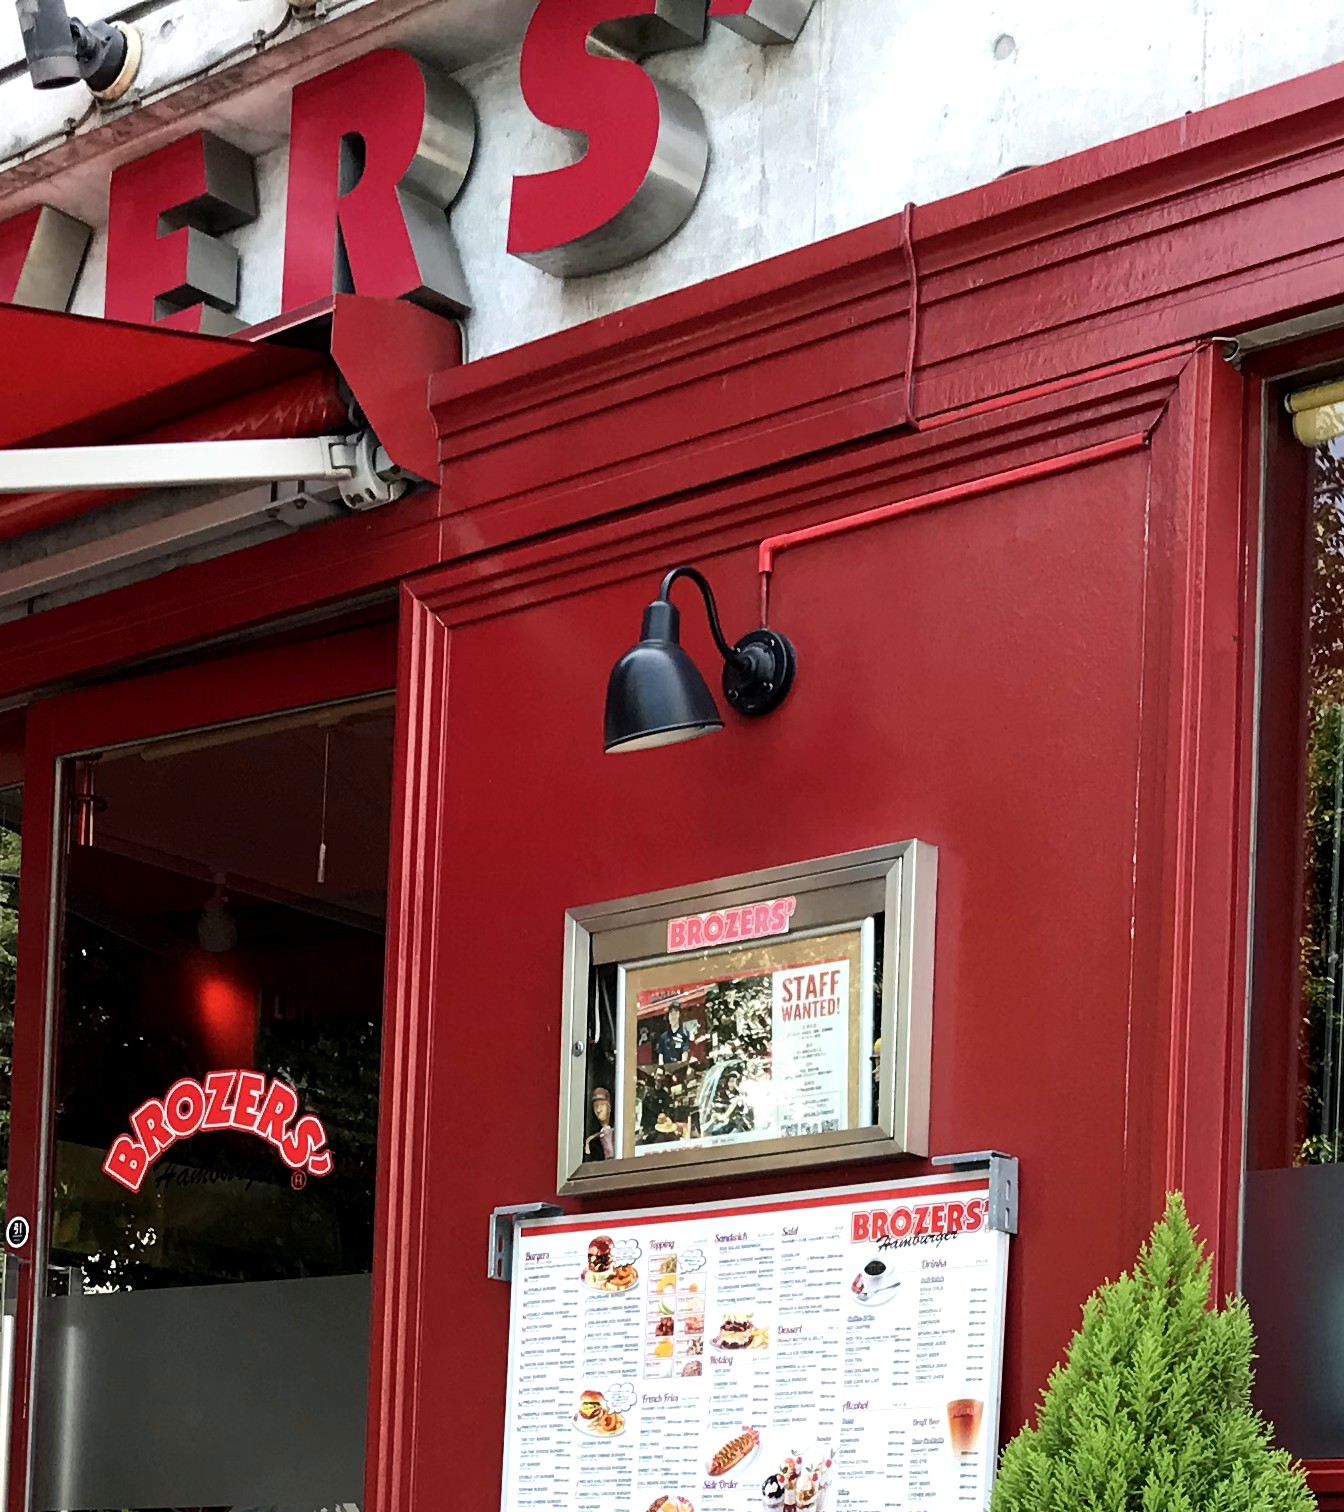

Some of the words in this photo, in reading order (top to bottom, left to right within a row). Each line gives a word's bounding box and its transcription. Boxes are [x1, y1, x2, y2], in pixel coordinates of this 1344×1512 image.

[781, 970, 841, 1003] STAFF
[781, 996, 841, 1023] WANTED!
[102, 1070, 334, 1193] BROZERS'
[649, 1239, 675, 1251] Topping
[876, 1230, 958, 1252] Hamburger
